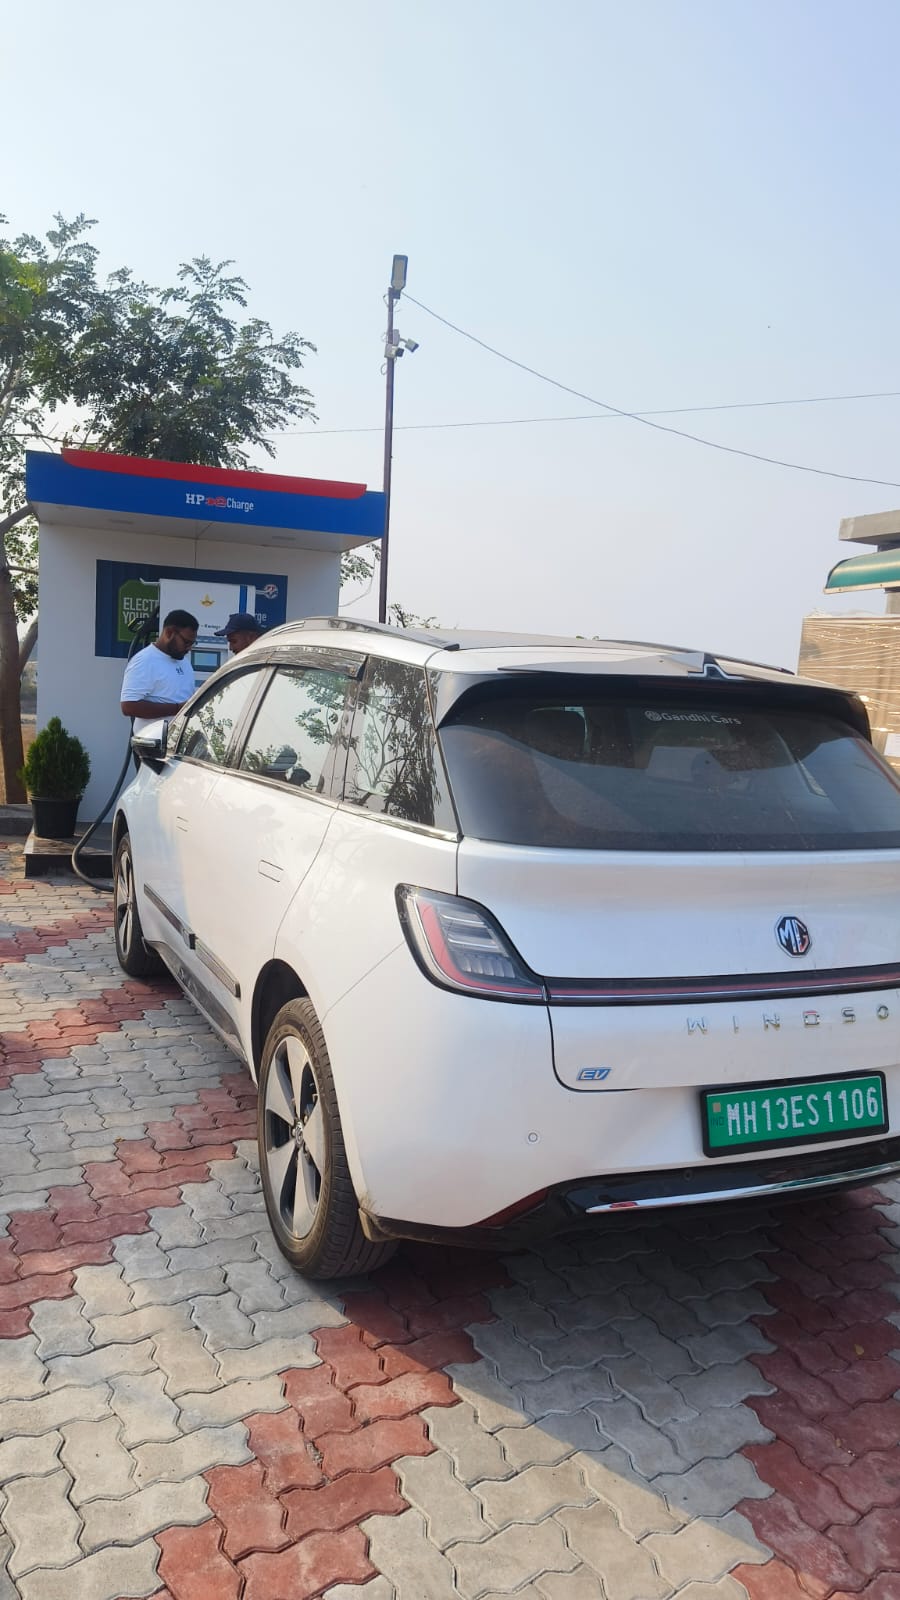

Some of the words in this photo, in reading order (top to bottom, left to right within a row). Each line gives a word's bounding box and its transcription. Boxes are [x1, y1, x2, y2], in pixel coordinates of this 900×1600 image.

[185, 493, 205, 505] HP
[226, 497, 254, 512] Charge
[661, 712, 710, 722] Gandhi
[710, 715, 742, 725] Cars
[779, 919, 809, 953] MG
[580, 1069, 609, 1080] EV
[726, 1086, 879, 1137] MH13ES1106
